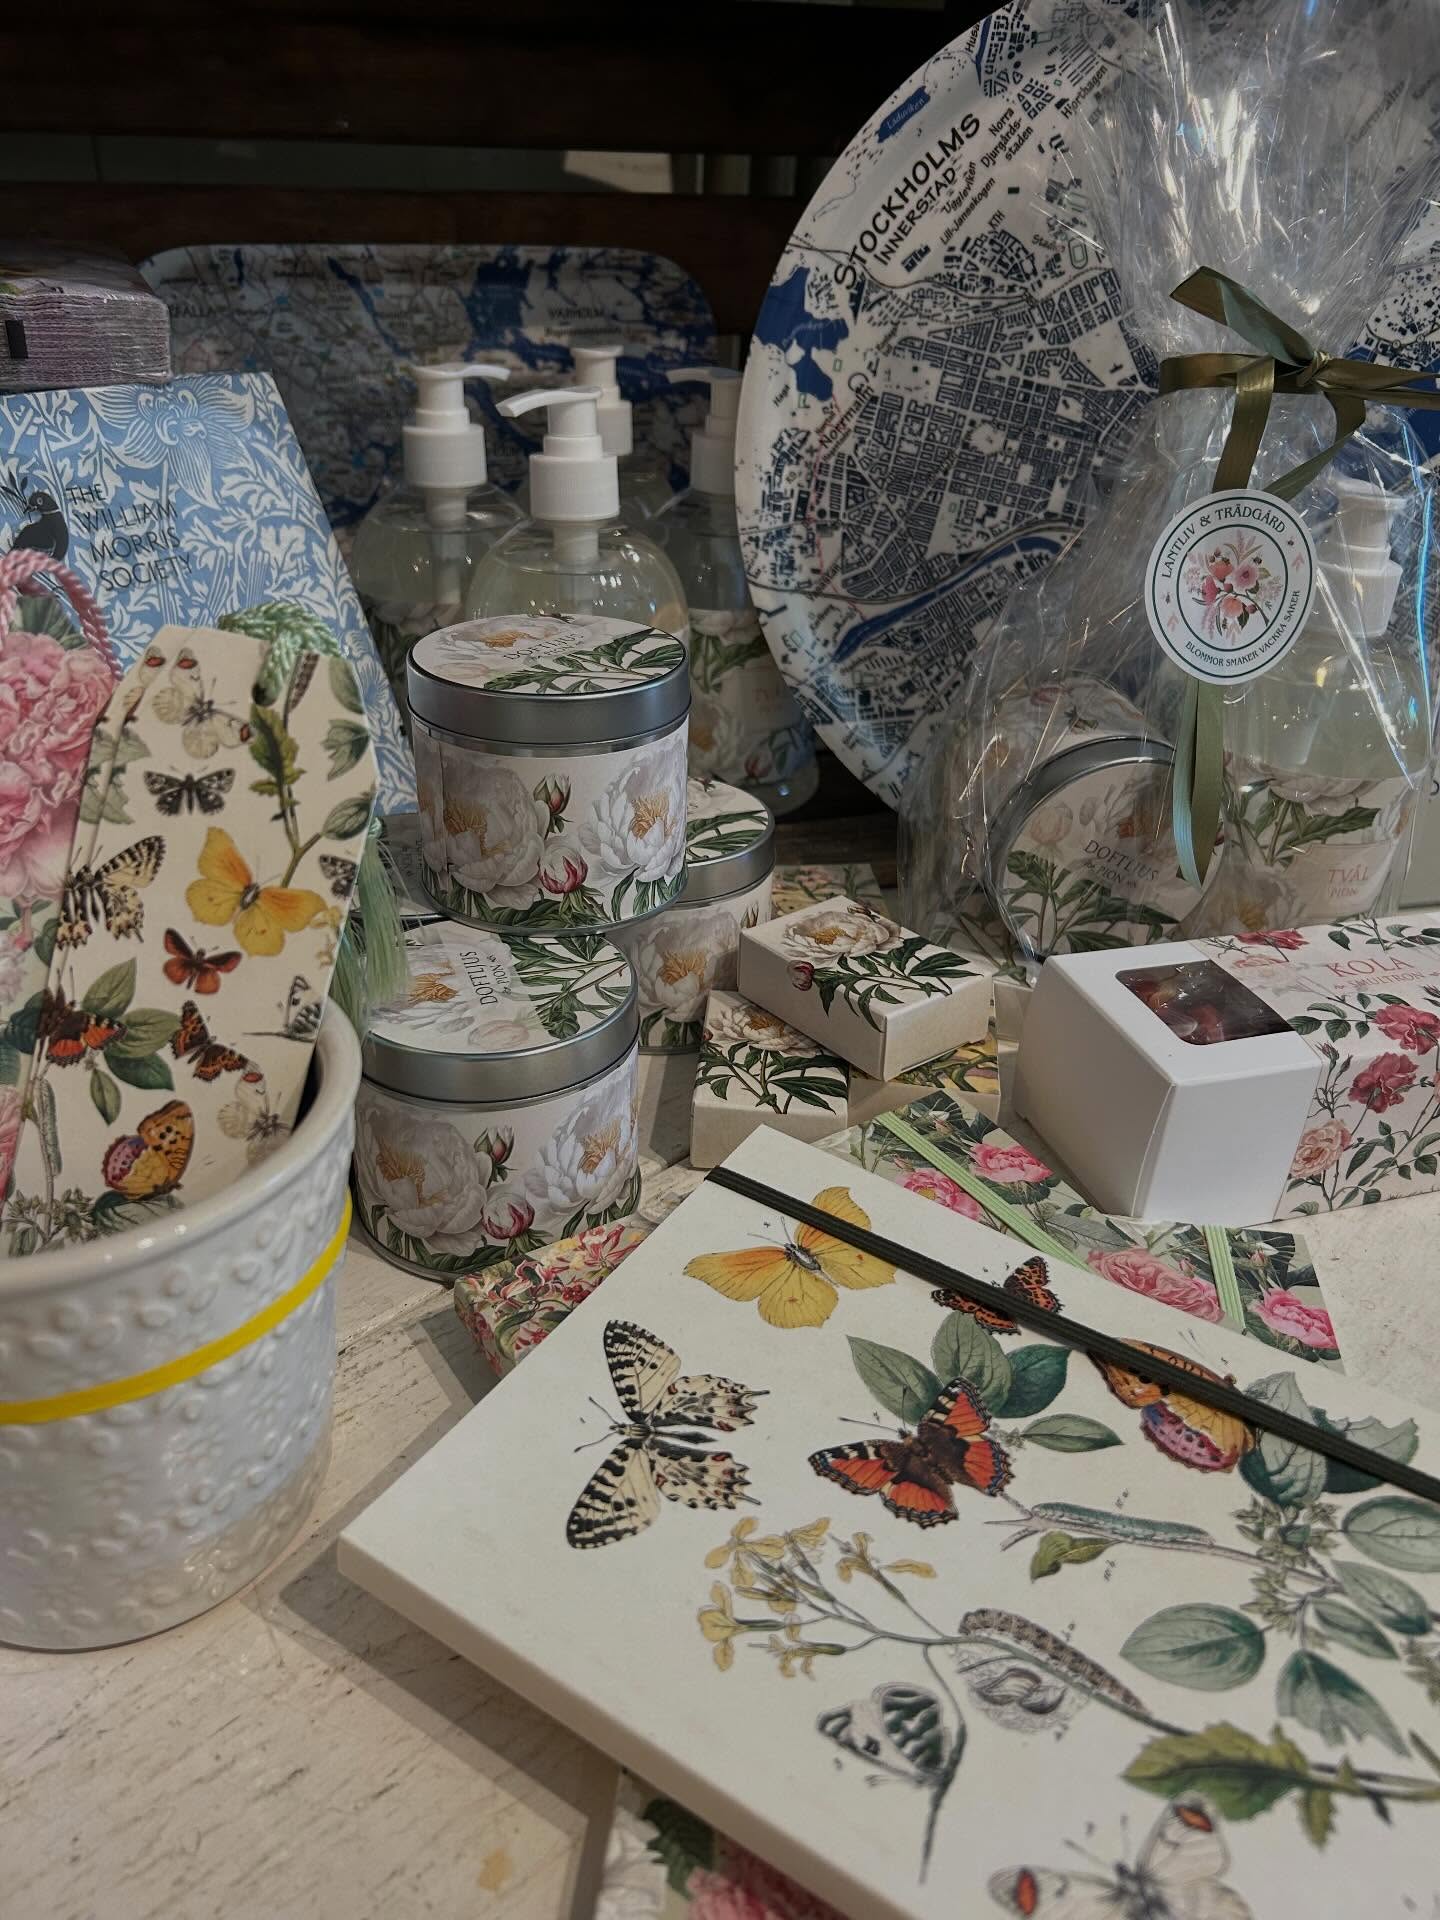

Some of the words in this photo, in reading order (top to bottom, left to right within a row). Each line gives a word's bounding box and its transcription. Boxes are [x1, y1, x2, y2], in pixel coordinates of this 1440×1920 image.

[1061, 65, 1108, 119] Hjorthagen
[989, 107, 1014, 137] Norra
[981, 117, 1022, 168] Djurgårds-
[1005, 125, 1033, 161] staden
[834, 113, 980, 289] STOCKHOLMS
[943, 161, 976, 214] Uggleviken
[874, 167, 956, 266] INNERSTAD
[988, 209, 1005, 230] KTH
[819, 383, 874, 448] Norrmalm
[66, 484, 106, 505] THE
[73, 500, 178, 533] WILLIAM
[90, 527, 180, 563] MORRIS
[1162, 523, 1195, 579] LANTLIV
[1199, 514, 1212, 527] &
[1215, 503, 1286, 534] TRÄDGÅRD
[100, 554, 192, 591] SOCIETY
[1185, 641, 1224, 667] BLOMMOR
[1226, 650, 1258, 667] SMAKER
[1259, 623, 1287, 654] VACKRA
[1284, 590, 1300, 622] SAKER
[1096, 865, 1122, 883] PION
[1328, 863, 1369, 883] TVÅL
[459, 951, 498, 1005] DOFTLJUS
[491, 964, 504, 985] PION
[1327, 956, 1415, 977] KOLA
[1350, 971, 1424, 988] SMULTRON
